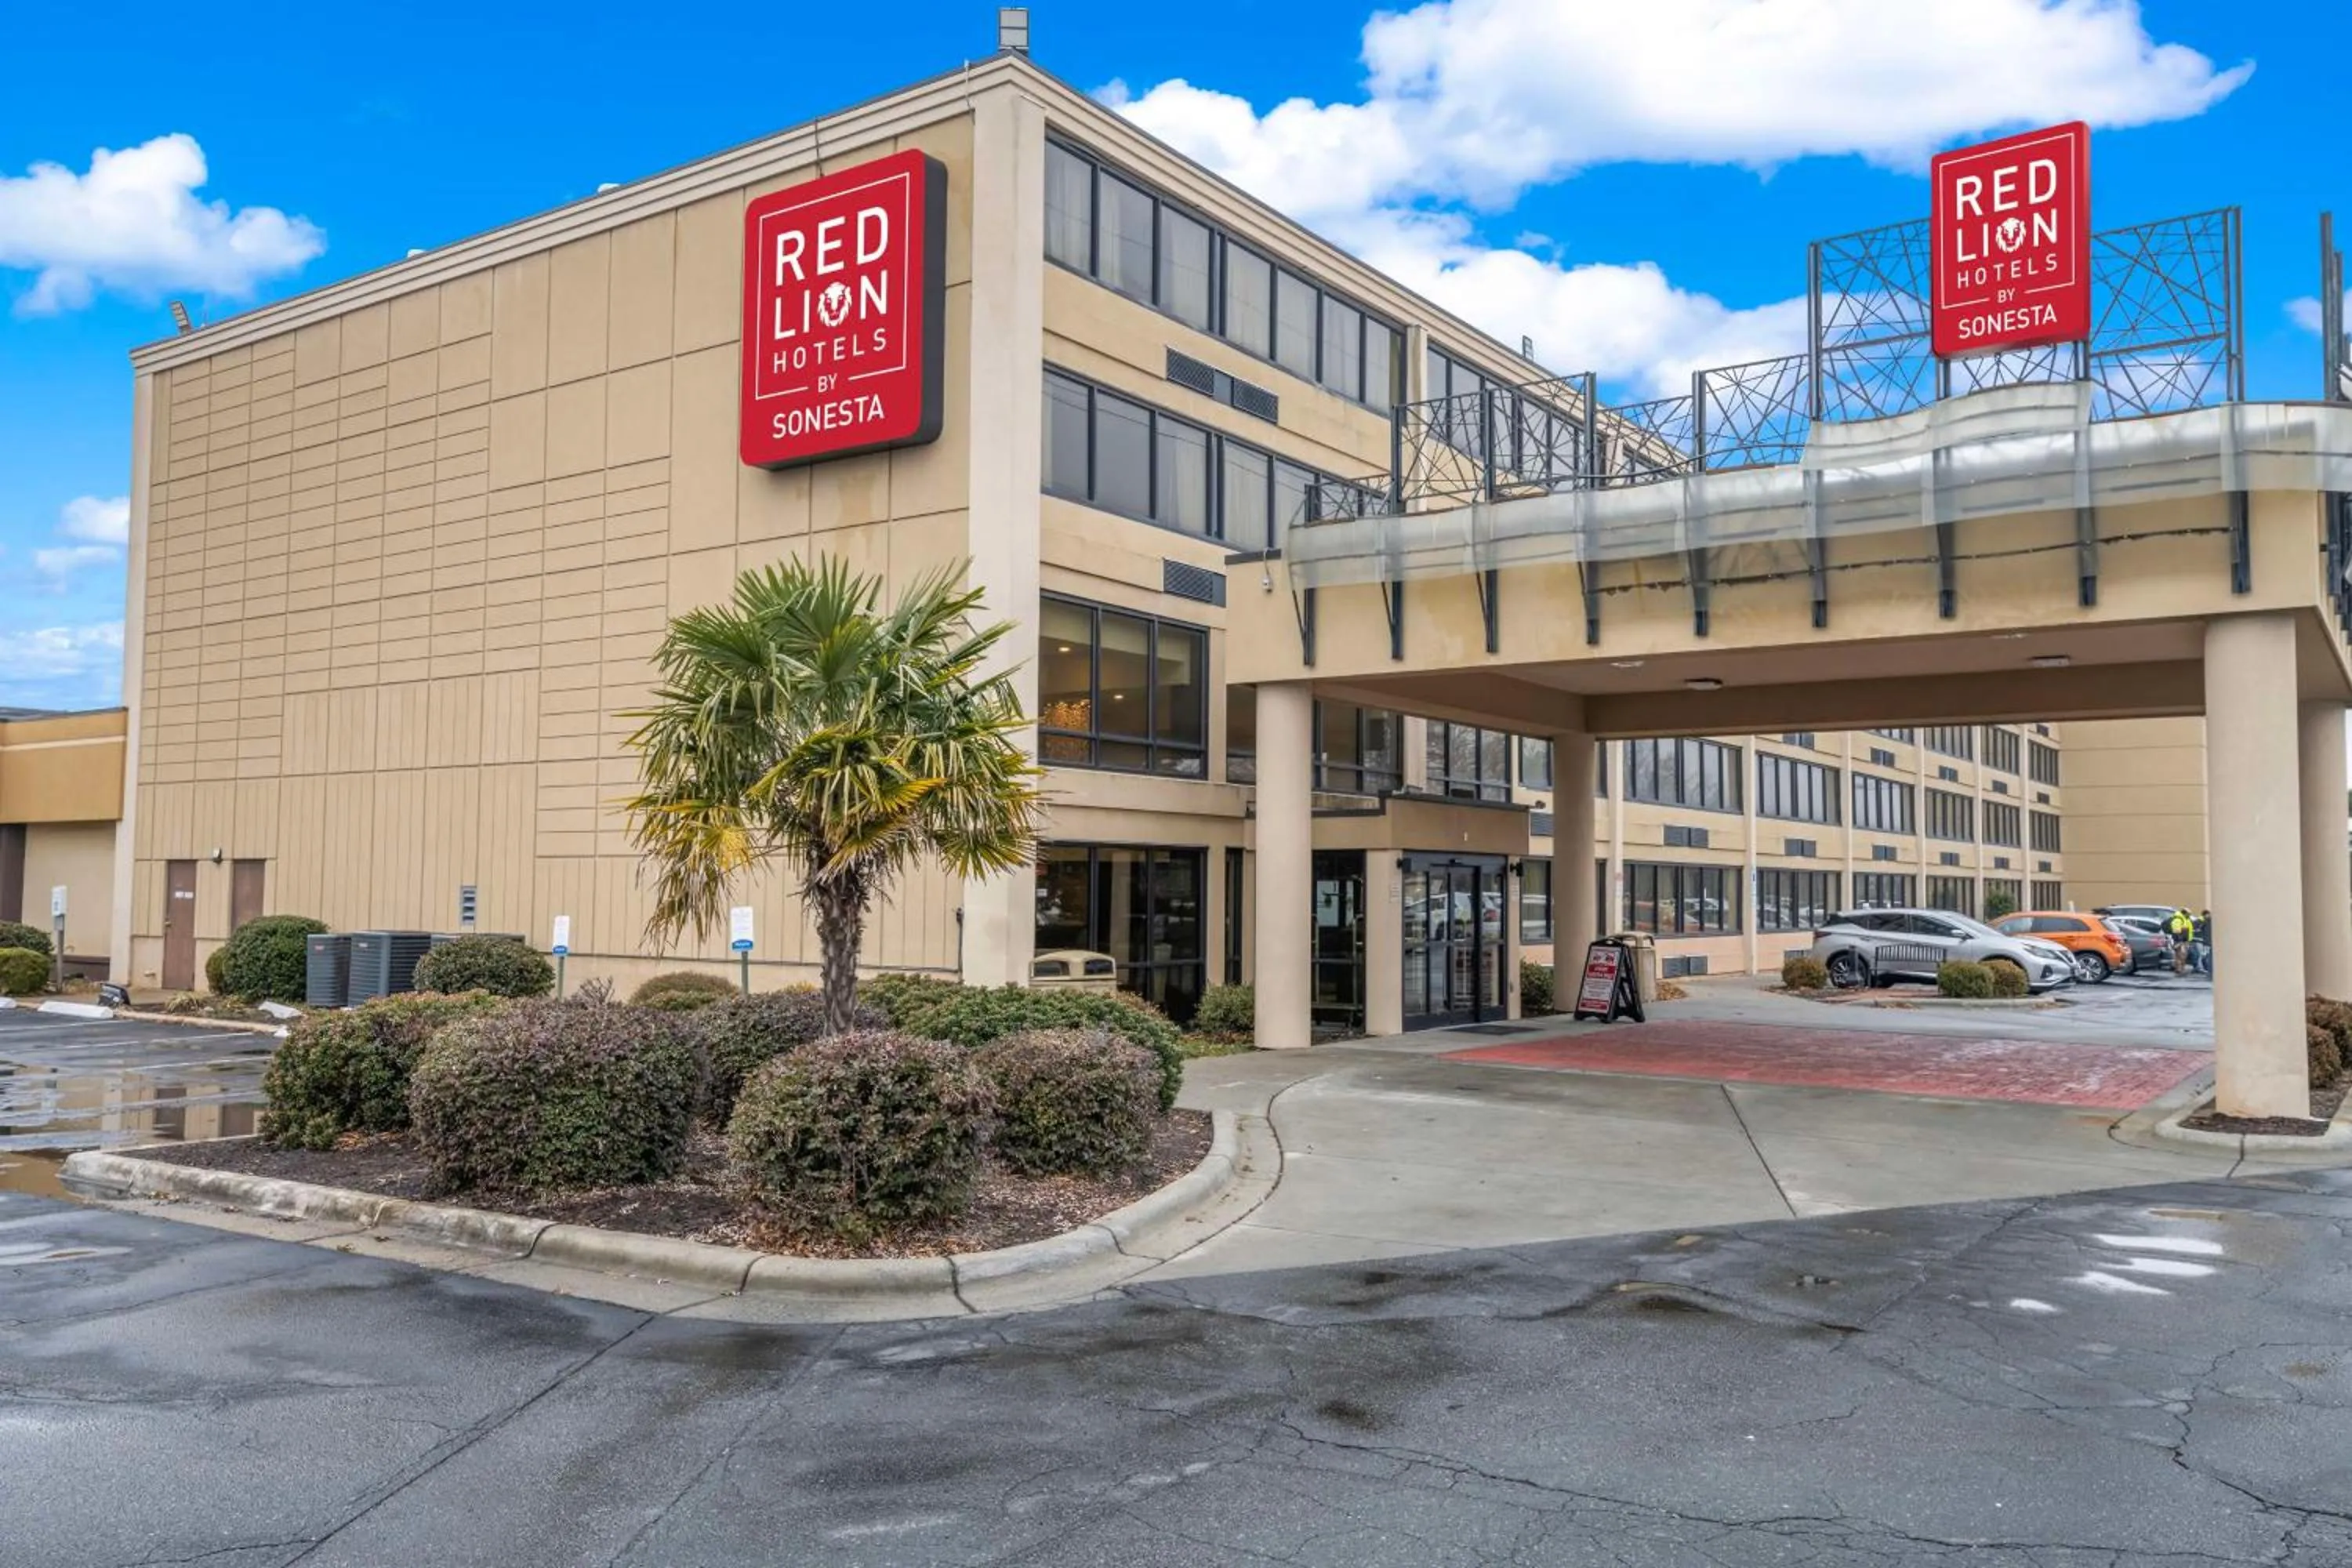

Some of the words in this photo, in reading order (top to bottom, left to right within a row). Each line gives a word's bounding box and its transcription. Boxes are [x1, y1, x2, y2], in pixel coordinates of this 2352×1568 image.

[1956, 158, 2057, 220] RED
[775, 205, 888, 286] RED
[1957, 253, 2057, 289] HOTELS
[1998, 288, 2015, 303] BY
[1958, 303, 2057, 339] SONESTA
[773, 328, 887, 374] HOTELS
[818, 373, 837, 393] BY
[772, 394, 884, 439] SONESTA
